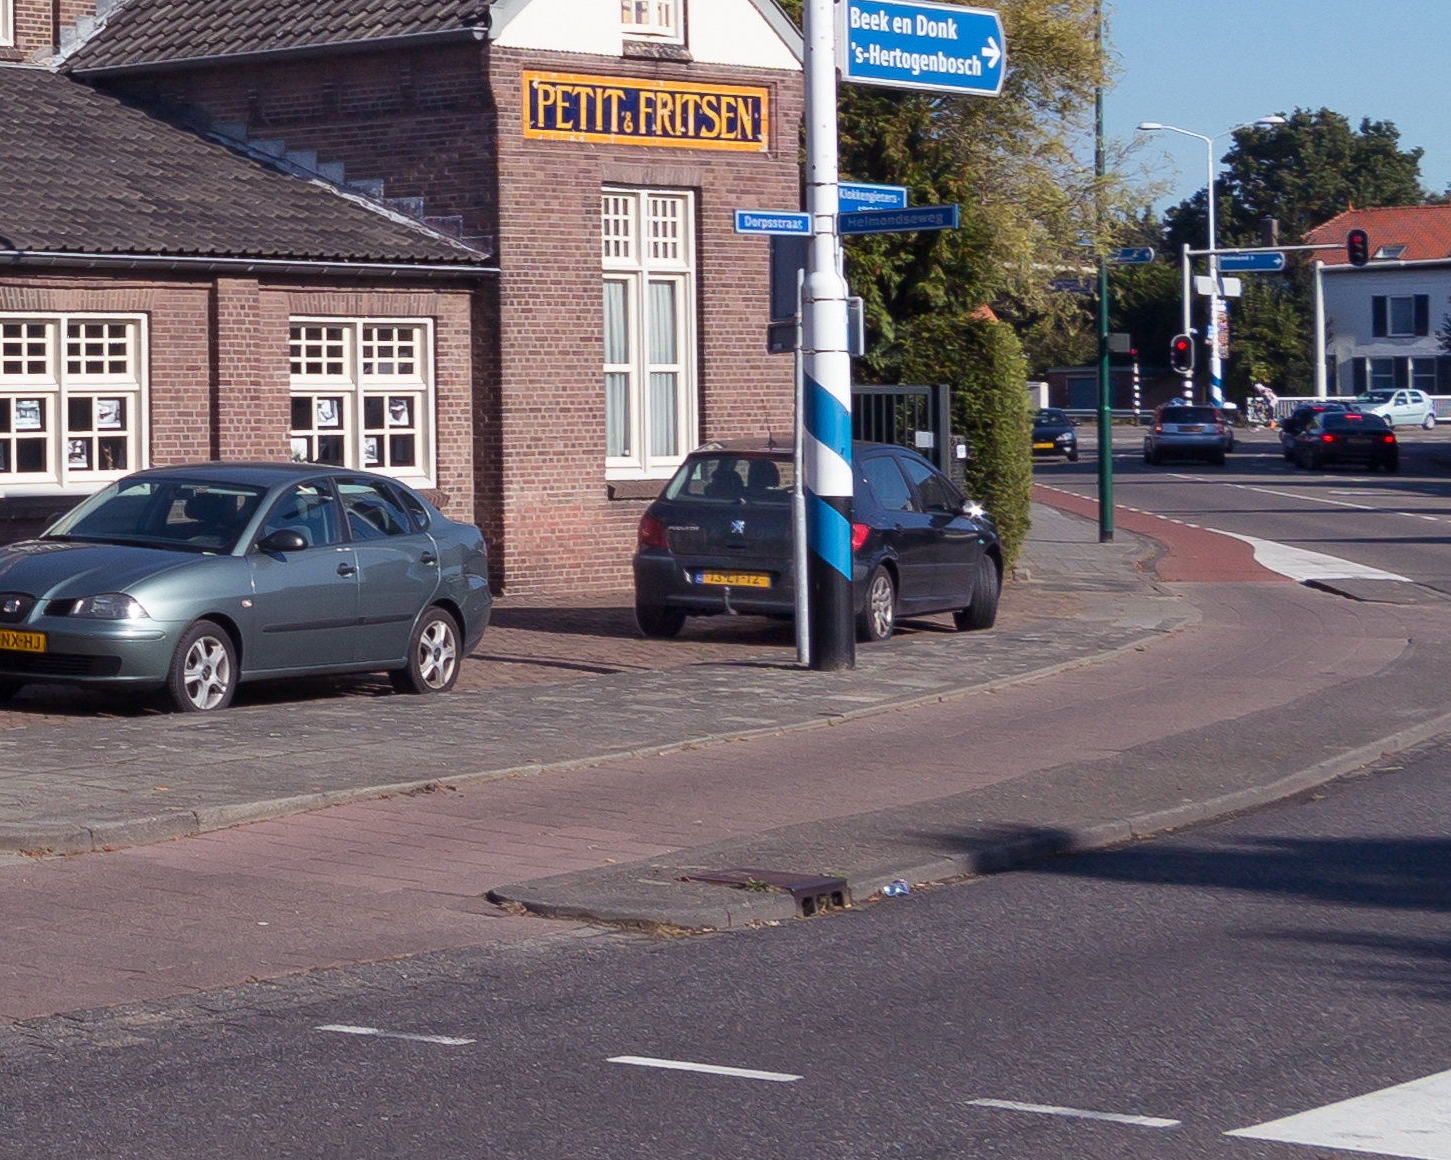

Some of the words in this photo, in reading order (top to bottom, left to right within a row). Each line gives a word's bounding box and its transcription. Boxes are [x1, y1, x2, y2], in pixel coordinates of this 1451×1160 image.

[850, 6, 890, 33] Beek
[892, 17, 912, 35] en
[916, 14, 959, 40] Donk
[850, 42, 983, 76] 's-Hertogenbosch
[536, 84, 627, 132] PETIT
[638, 90, 754, 140] FRITSEN
[744, 215, 804, 229] Dorpsstraat
[847, 213, 944, 228] Helmondseweg
